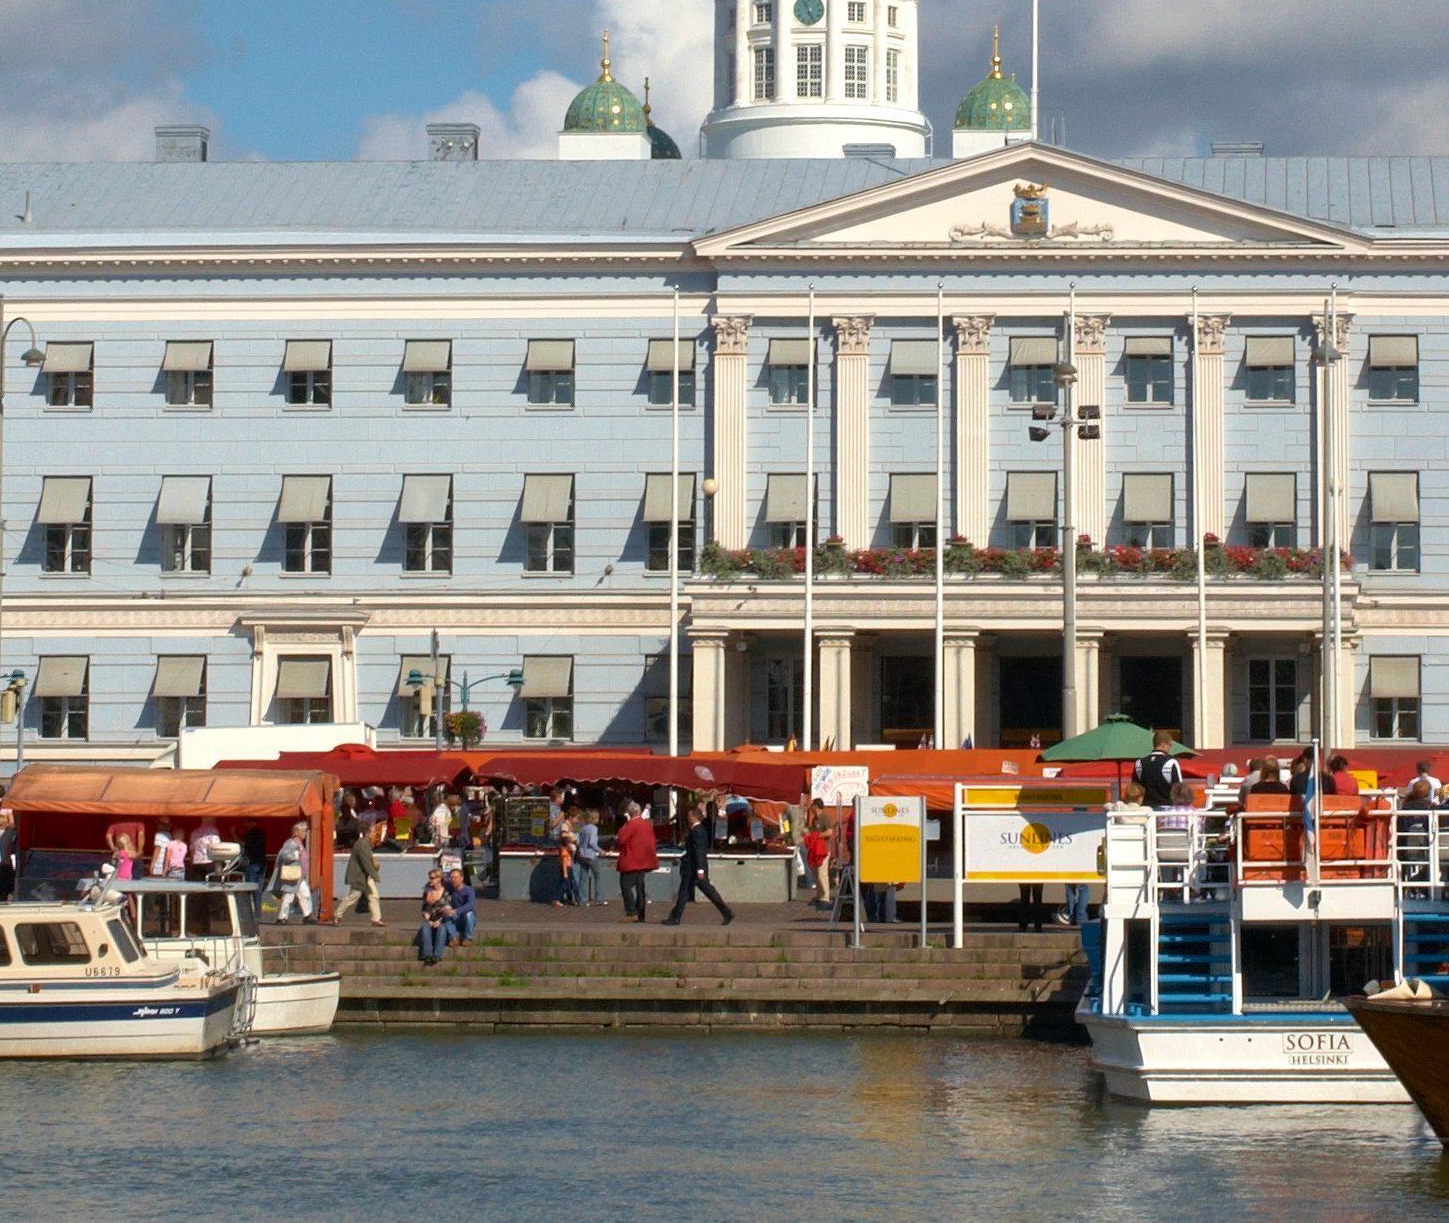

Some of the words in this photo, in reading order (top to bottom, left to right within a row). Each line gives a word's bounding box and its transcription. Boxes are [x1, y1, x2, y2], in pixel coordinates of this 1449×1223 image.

[1000, 831, 1073, 845] SUNLINES
[85, 966, 121, 977] U6679
[1286, 1033, 1351, 1051] SOFIA
[1292, 1054, 1349, 1066] HELSINKI
